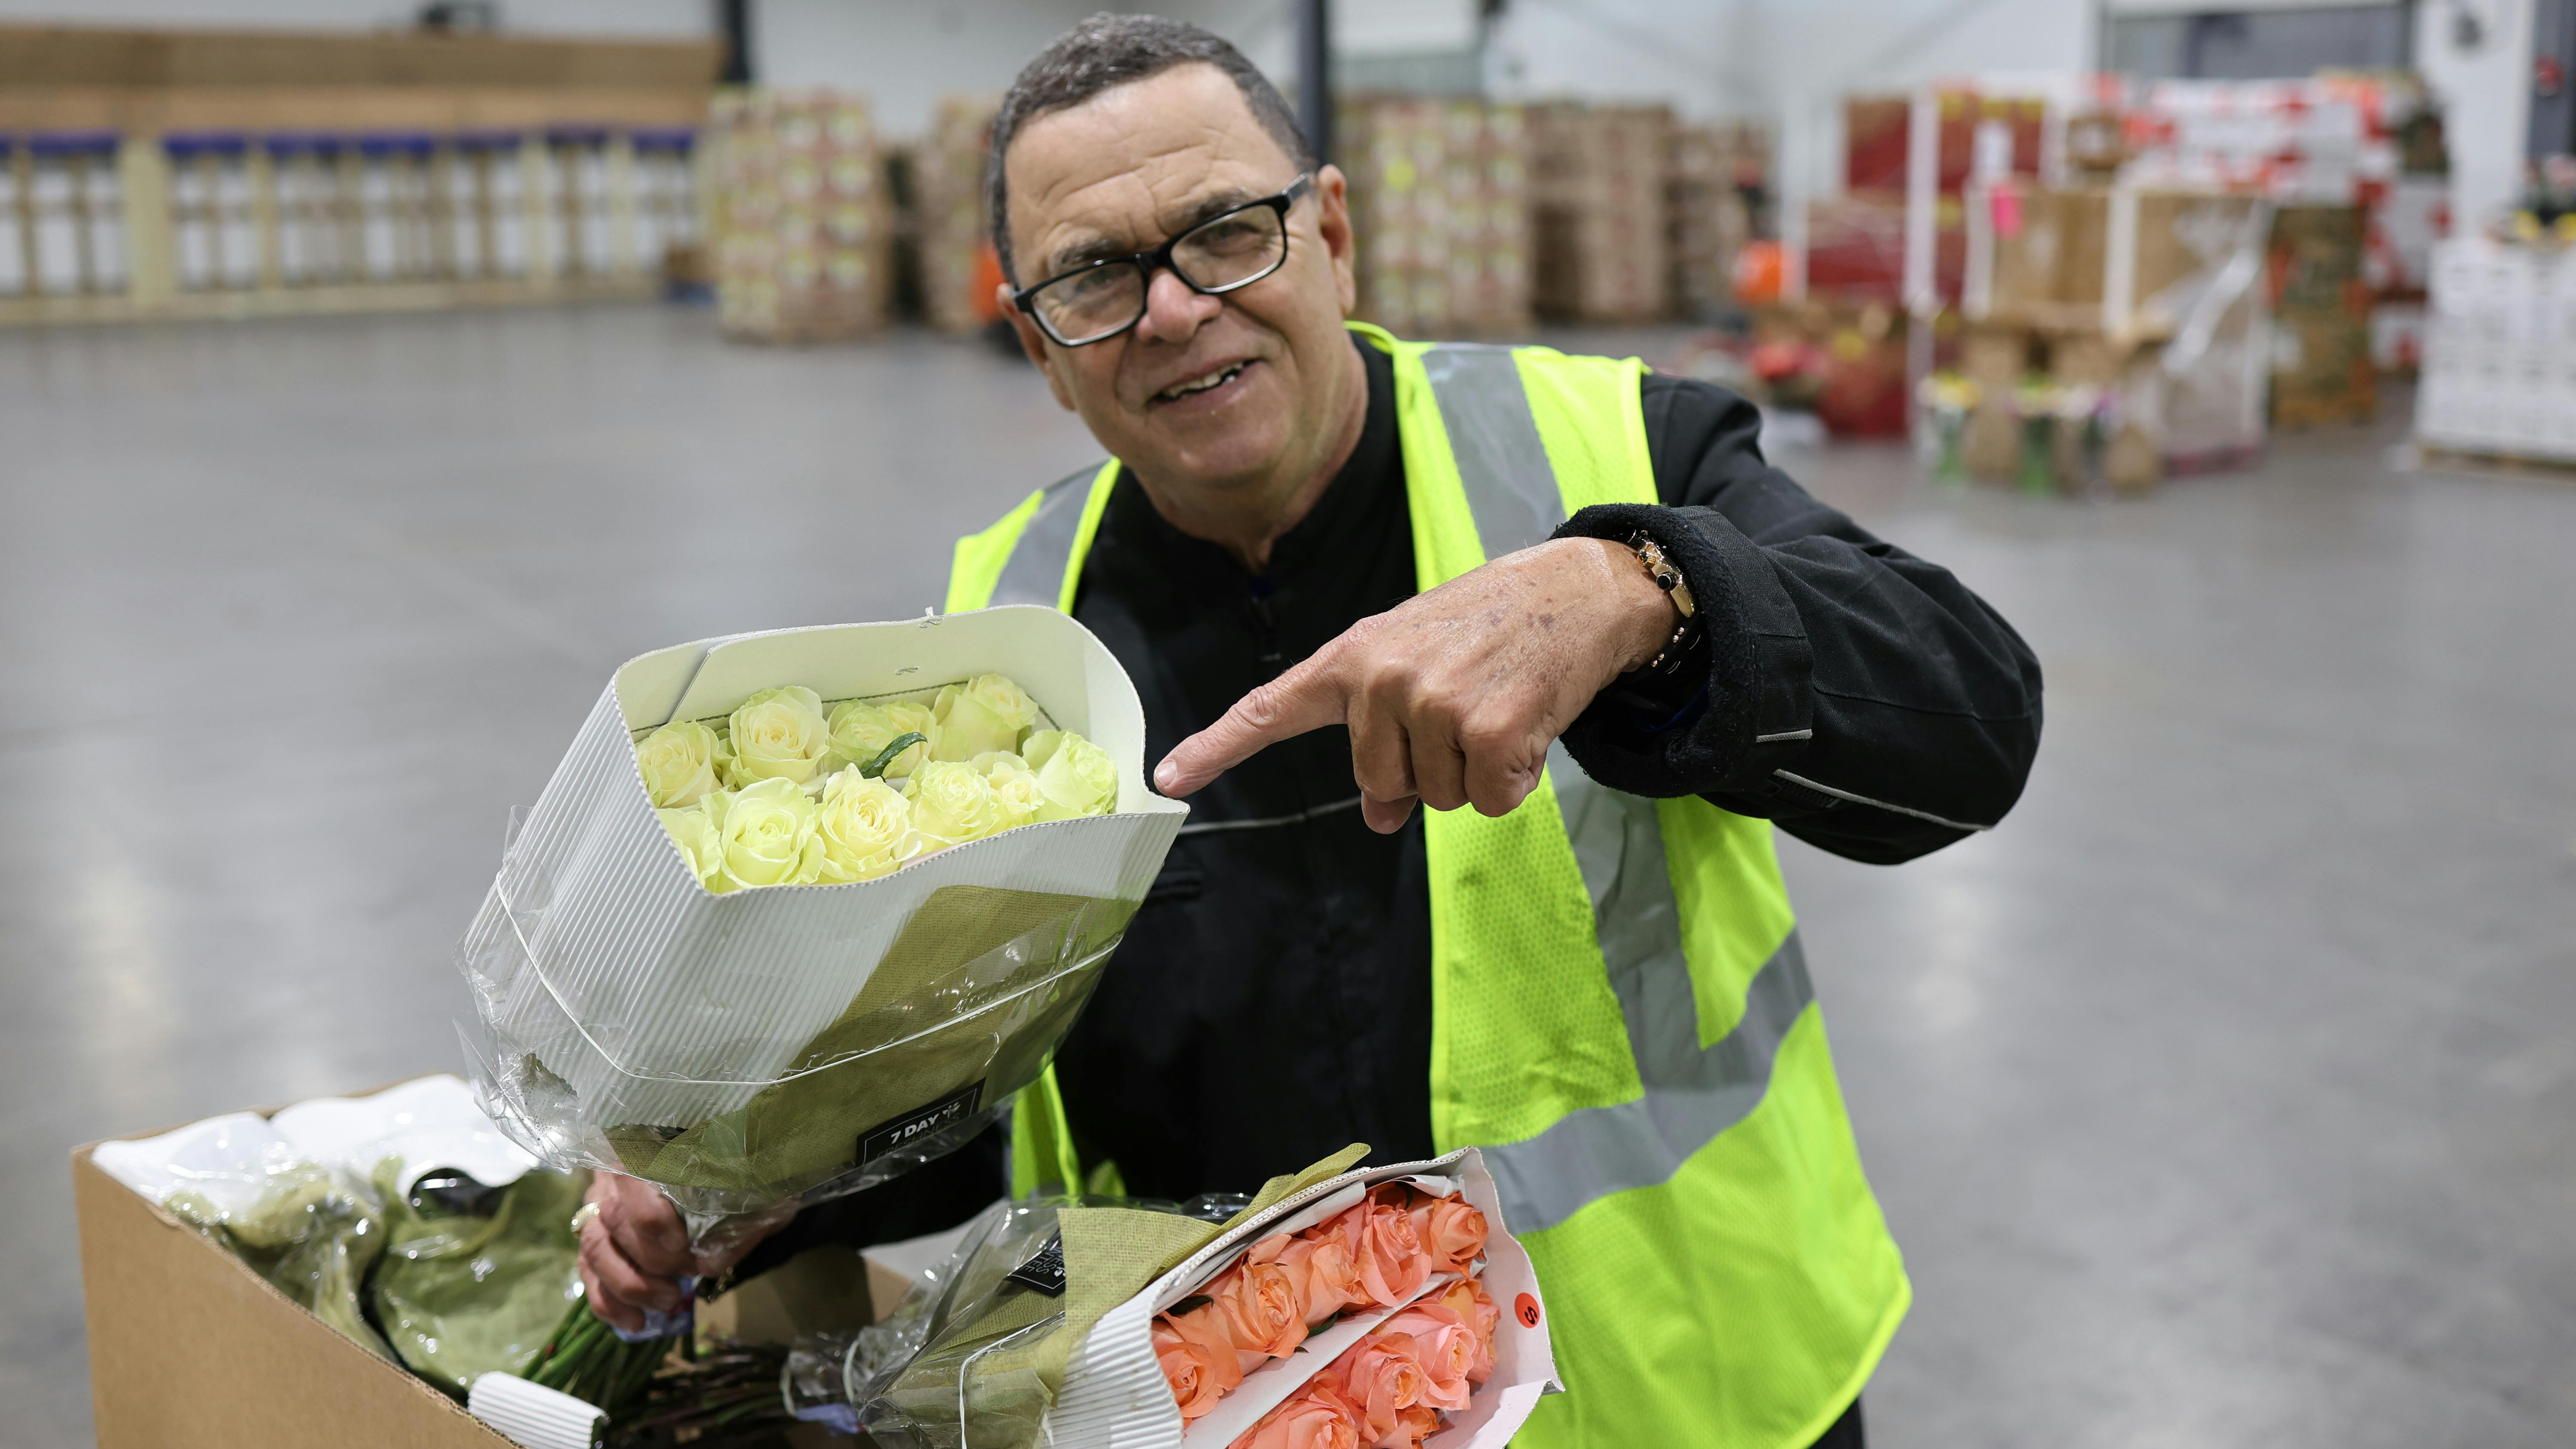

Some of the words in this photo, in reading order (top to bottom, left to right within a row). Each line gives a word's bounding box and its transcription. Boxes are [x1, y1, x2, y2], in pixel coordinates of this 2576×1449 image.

[891, 1130, 901, 1144] 7
[904, 1113, 939, 1138] DAY
[1525, 1306, 1537, 1325] S
